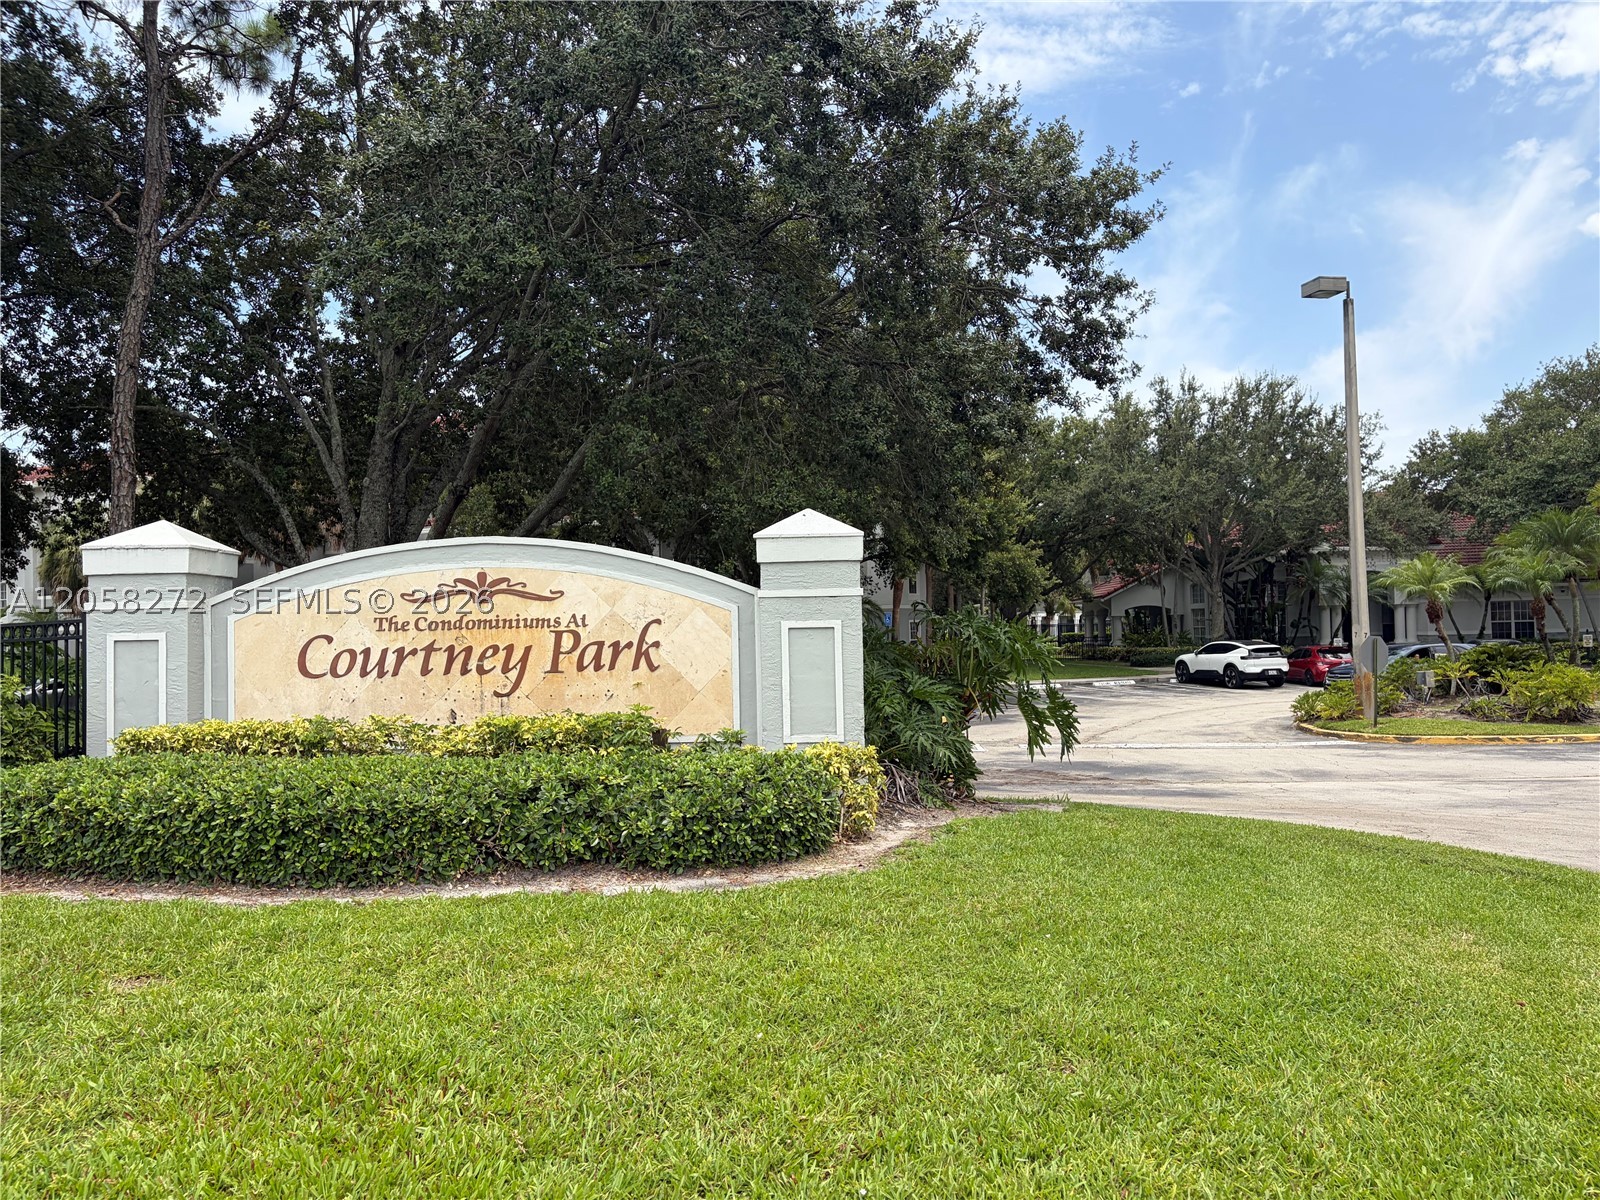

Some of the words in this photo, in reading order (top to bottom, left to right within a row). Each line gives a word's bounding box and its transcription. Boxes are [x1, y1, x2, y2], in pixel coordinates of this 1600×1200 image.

[373, 615, 411, 632] The
[414, 613, 561, 632] Condominiums
[565, 613, 588, 628] At
[297, 634, 533, 697] Courtney
[544, 618, 662, 675] Park
